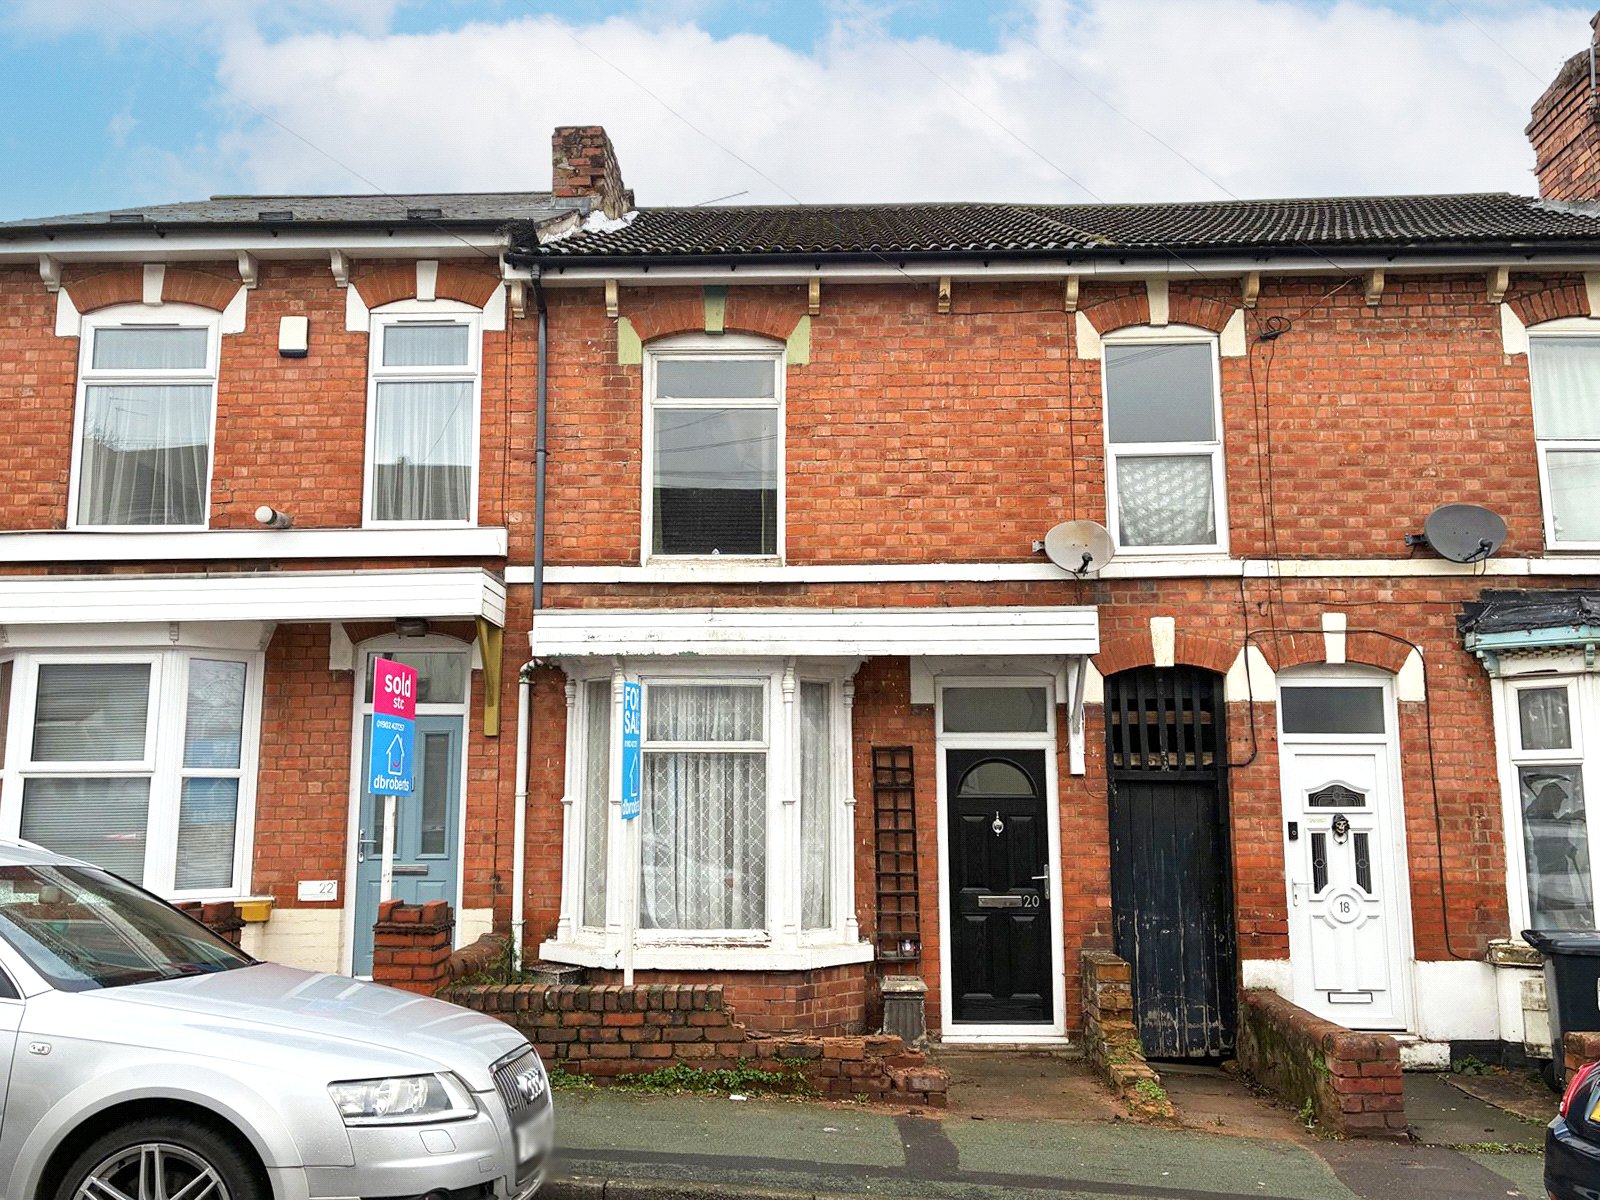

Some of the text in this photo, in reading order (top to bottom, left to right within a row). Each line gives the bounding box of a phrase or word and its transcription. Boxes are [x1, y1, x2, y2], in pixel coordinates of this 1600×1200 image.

[384, 672, 411, 697] sold
[393, 696, 405, 710] stc
[319, 882, 335, 894] 22
[1023, 895, 1040, 908] 20
[1339, 901, 1351, 914] 18
